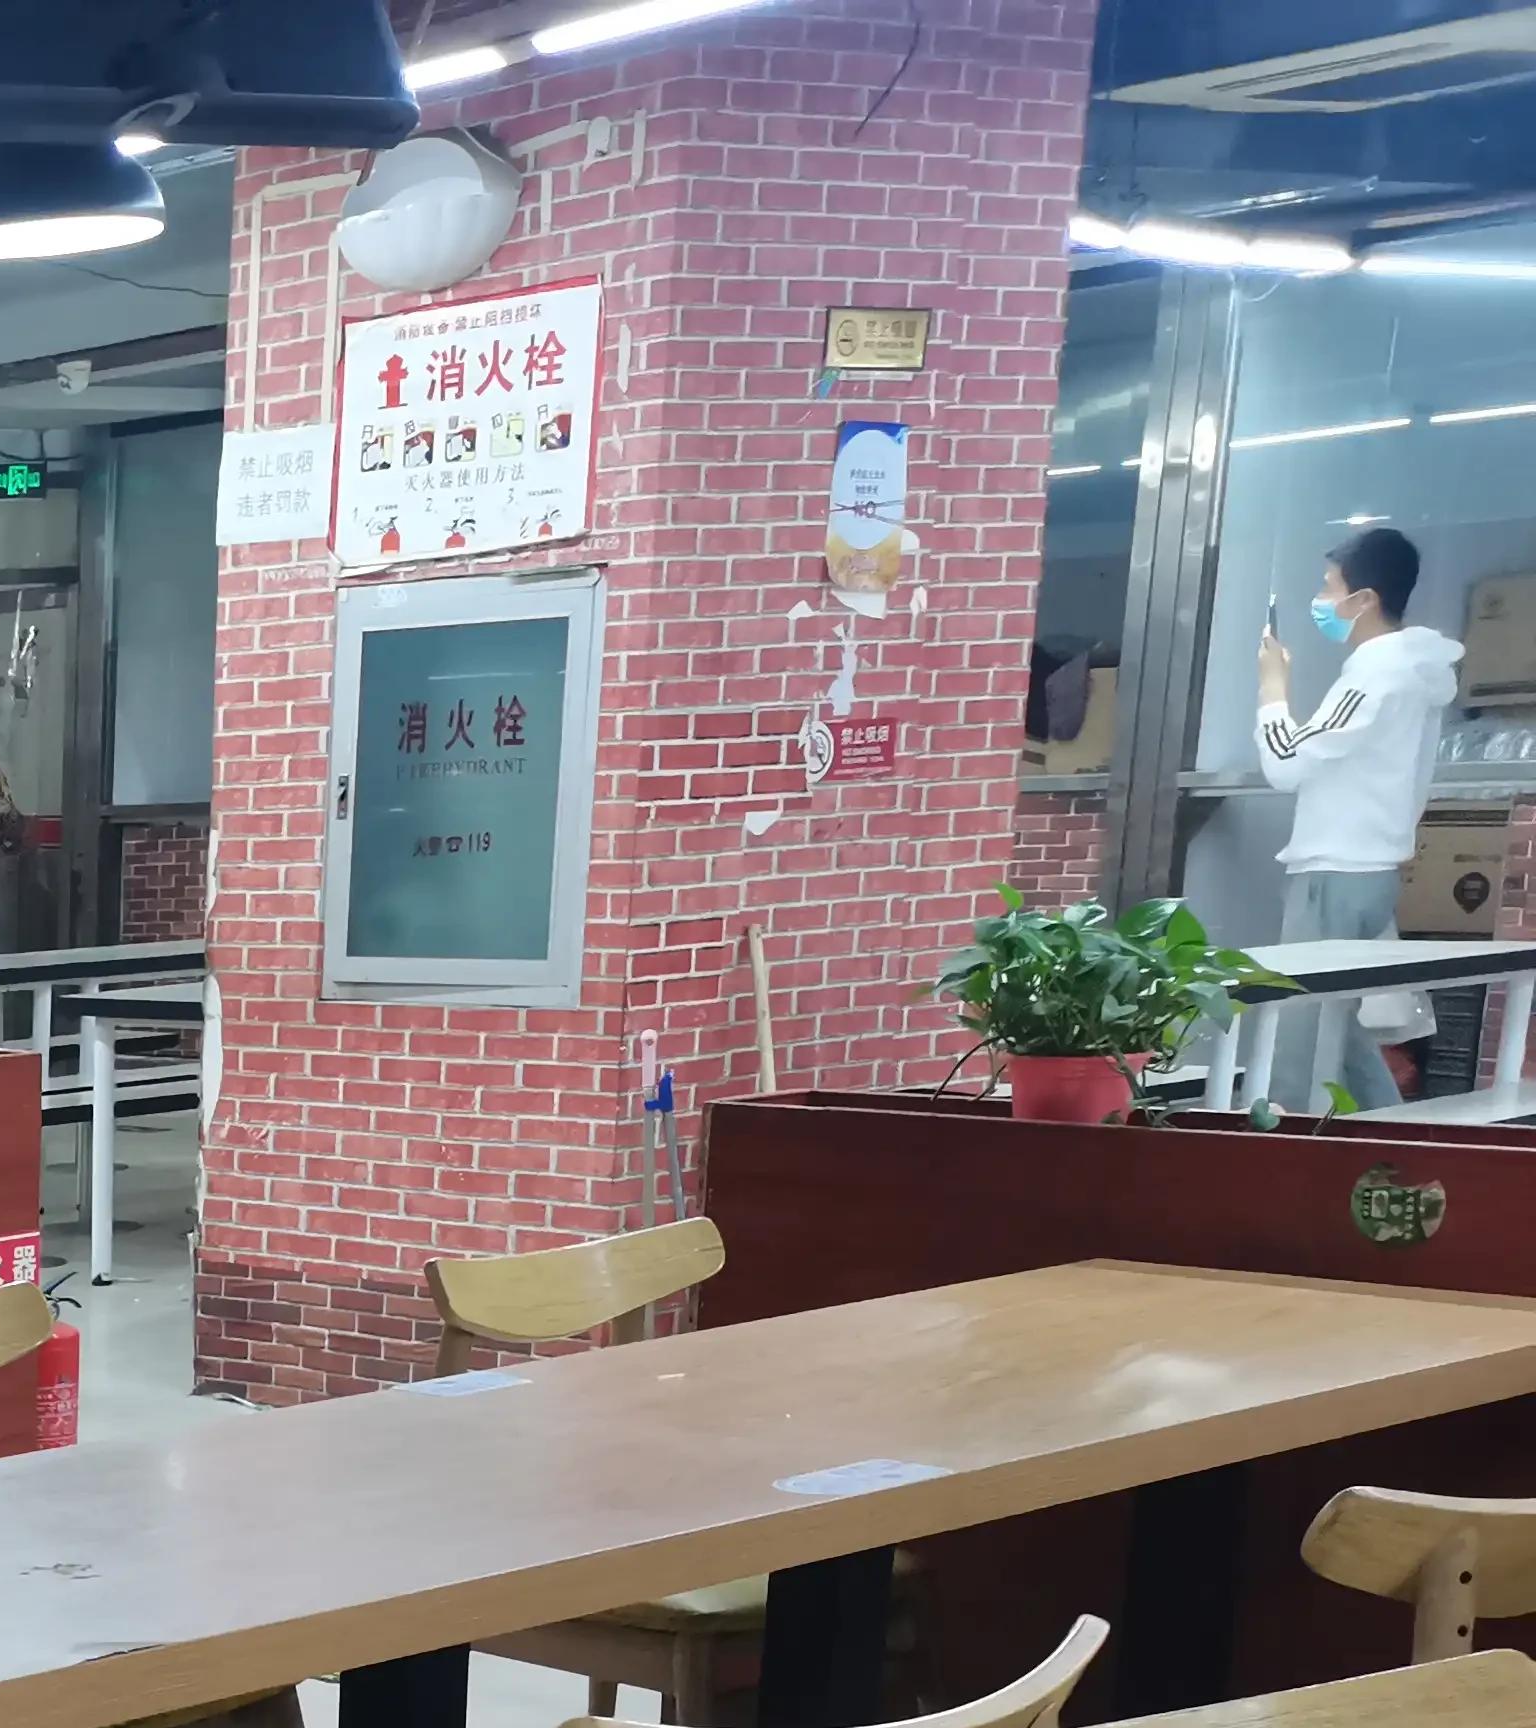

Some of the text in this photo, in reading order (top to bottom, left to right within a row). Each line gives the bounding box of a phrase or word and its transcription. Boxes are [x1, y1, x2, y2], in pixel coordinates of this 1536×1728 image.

[425, 330, 567, 401] 消火栓
[238, 449, 314, 480] 禁止吸烟
[404, 462, 526, 493] 灭火器使用方法
[235, 487, 311, 518] 违者罚款
[397, 695, 527, 754] 消火栓
[468, 831, 491, 853] 119
